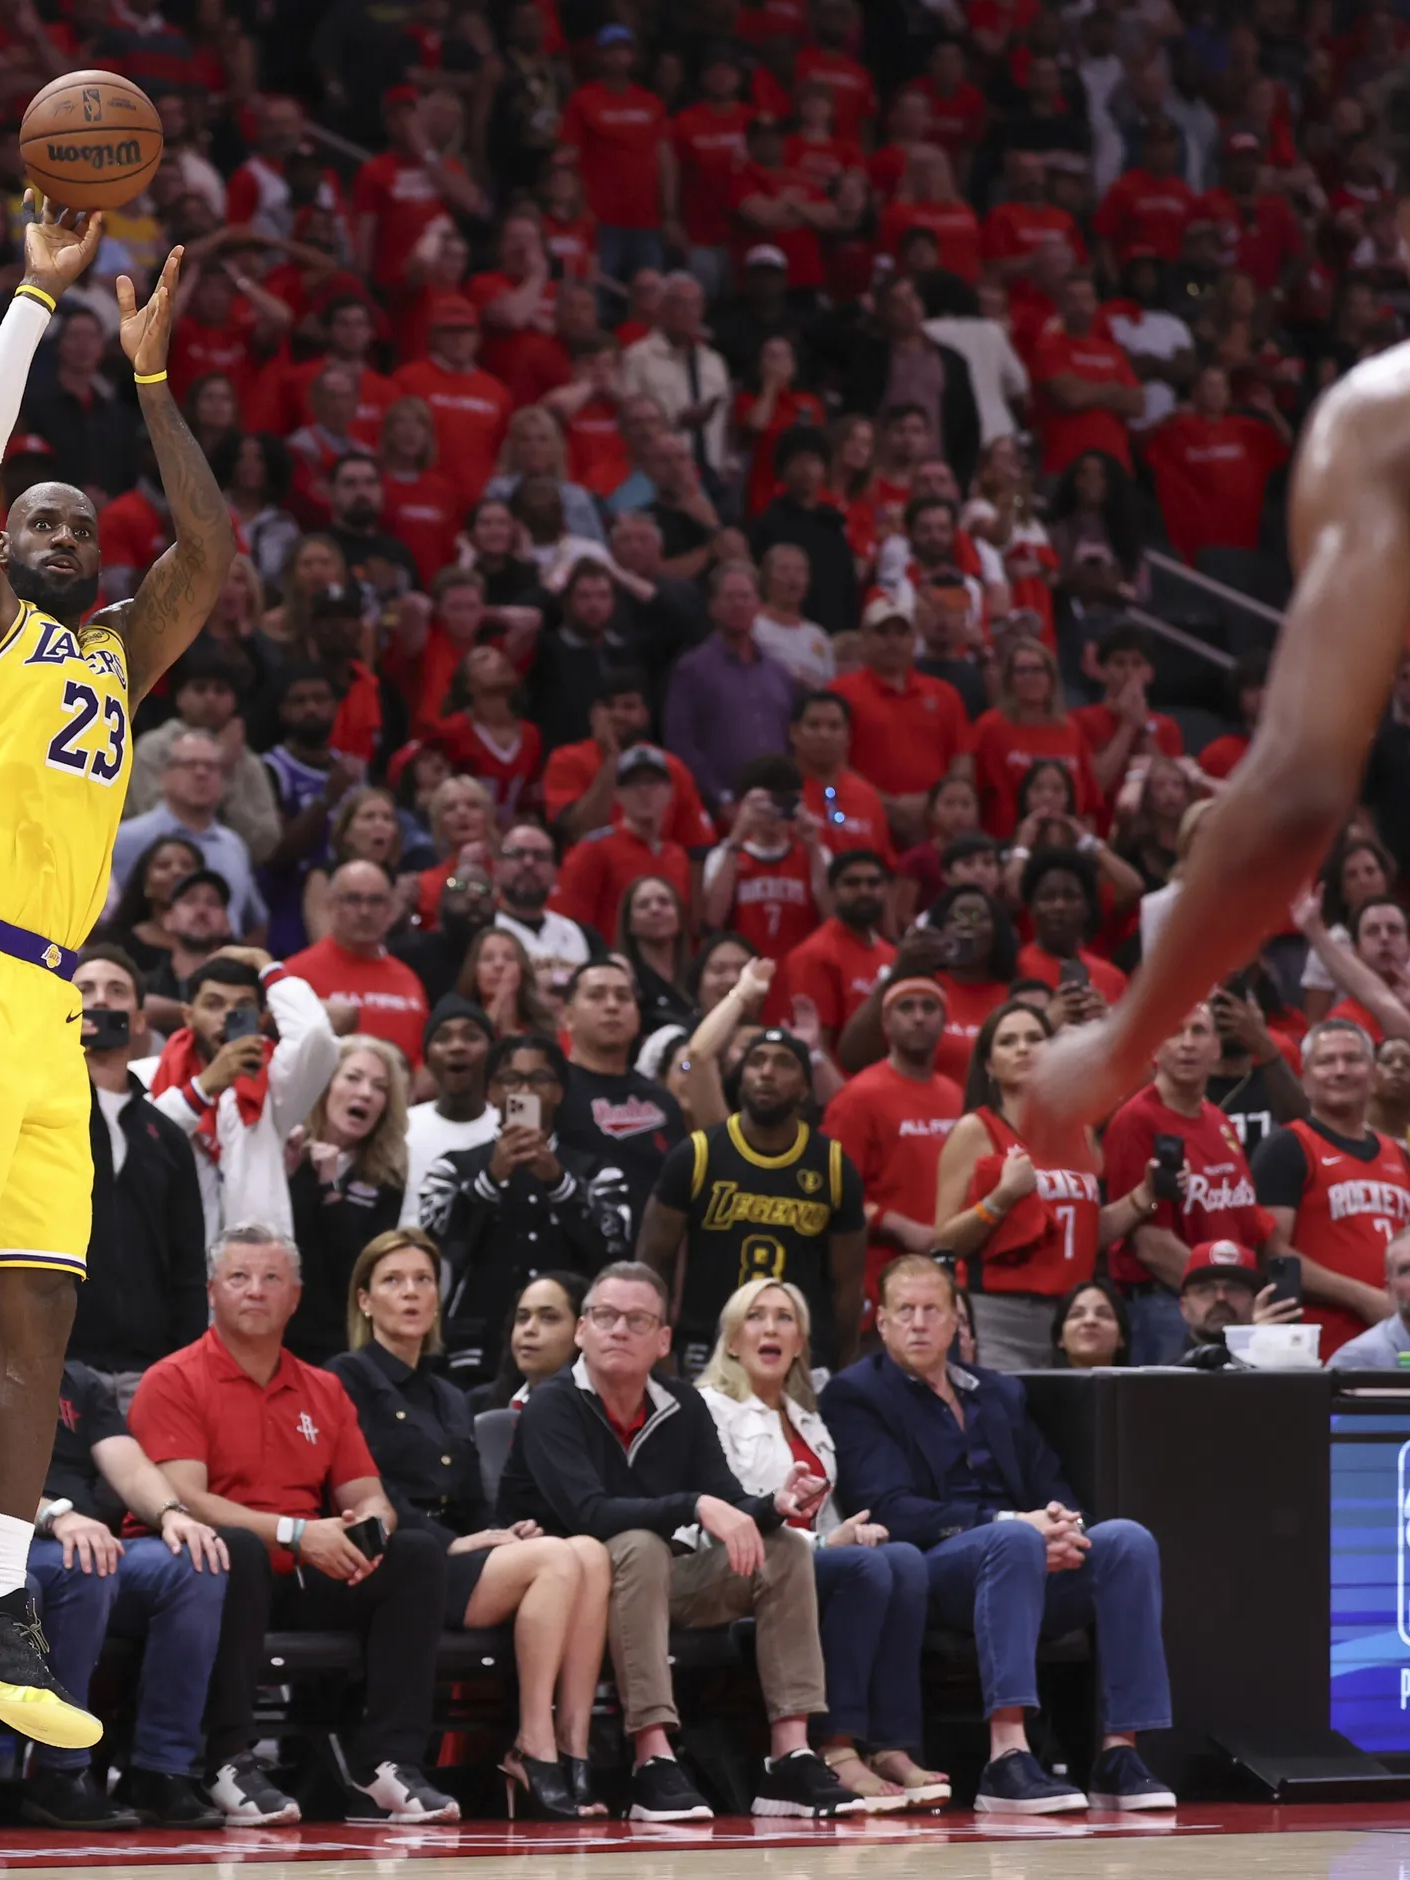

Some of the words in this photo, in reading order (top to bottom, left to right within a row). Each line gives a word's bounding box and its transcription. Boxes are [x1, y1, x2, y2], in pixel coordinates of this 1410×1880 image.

[47, 140, 142, 169] Wilson
[21, 621, 127, 692] LAERS
[44, 678, 128, 788] 23
[1055, 1205, 1076, 1260] 7
